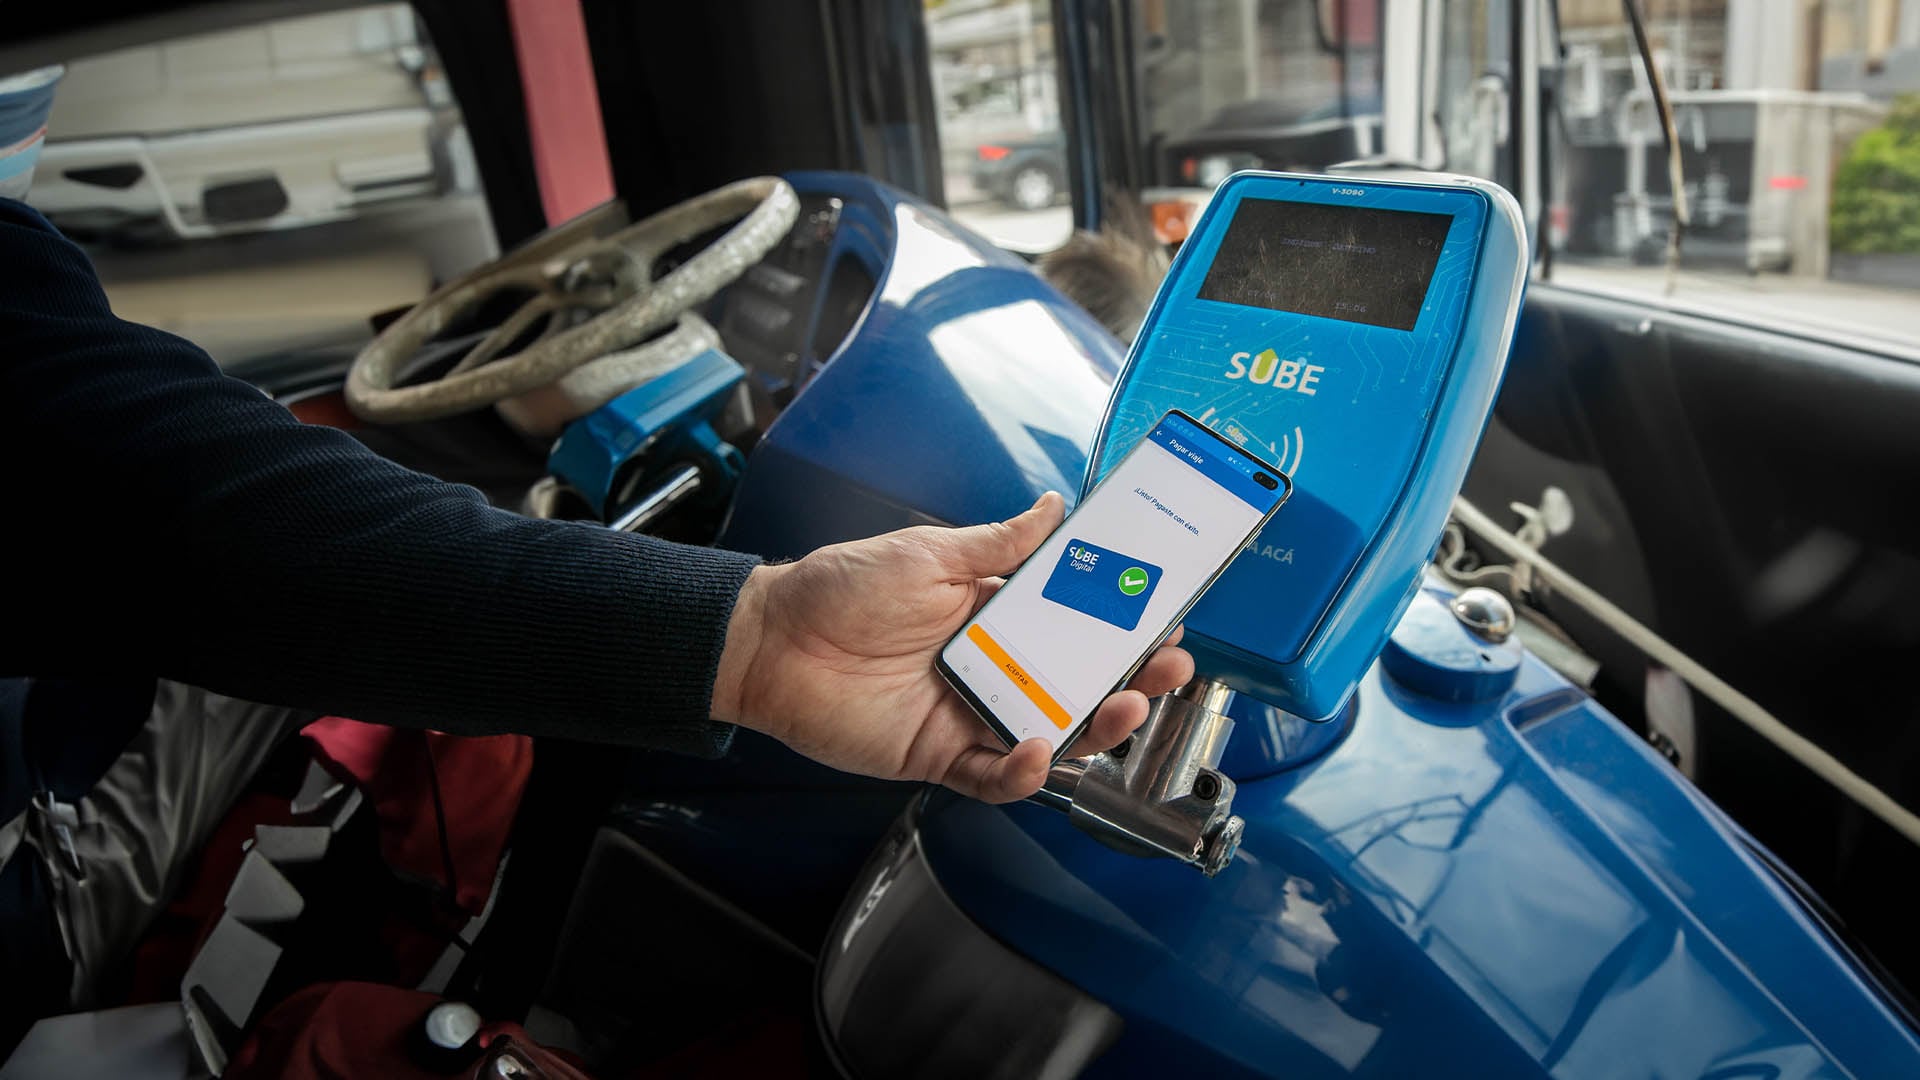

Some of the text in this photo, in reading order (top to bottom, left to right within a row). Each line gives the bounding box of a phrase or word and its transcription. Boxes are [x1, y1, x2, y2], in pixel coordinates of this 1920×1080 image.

[1331, 187, 1365, 197] V-3090
[1224, 348, 1325, 396] SUBE
[1224, 424, 1249, 446] SUBE
[1169, 439, 1204, 465] Pagar viaje
[1150, 498, 1174, 517] Pagaste
[1173, 515, 1185, 525] con
[1069, 546, 1100, 566] SUBE
[1261, 545, 1295, 565] ACÁ
[1070, 560, 1095, 573] Digital
[1005, 663, 1029, 686] ACEPTAR
